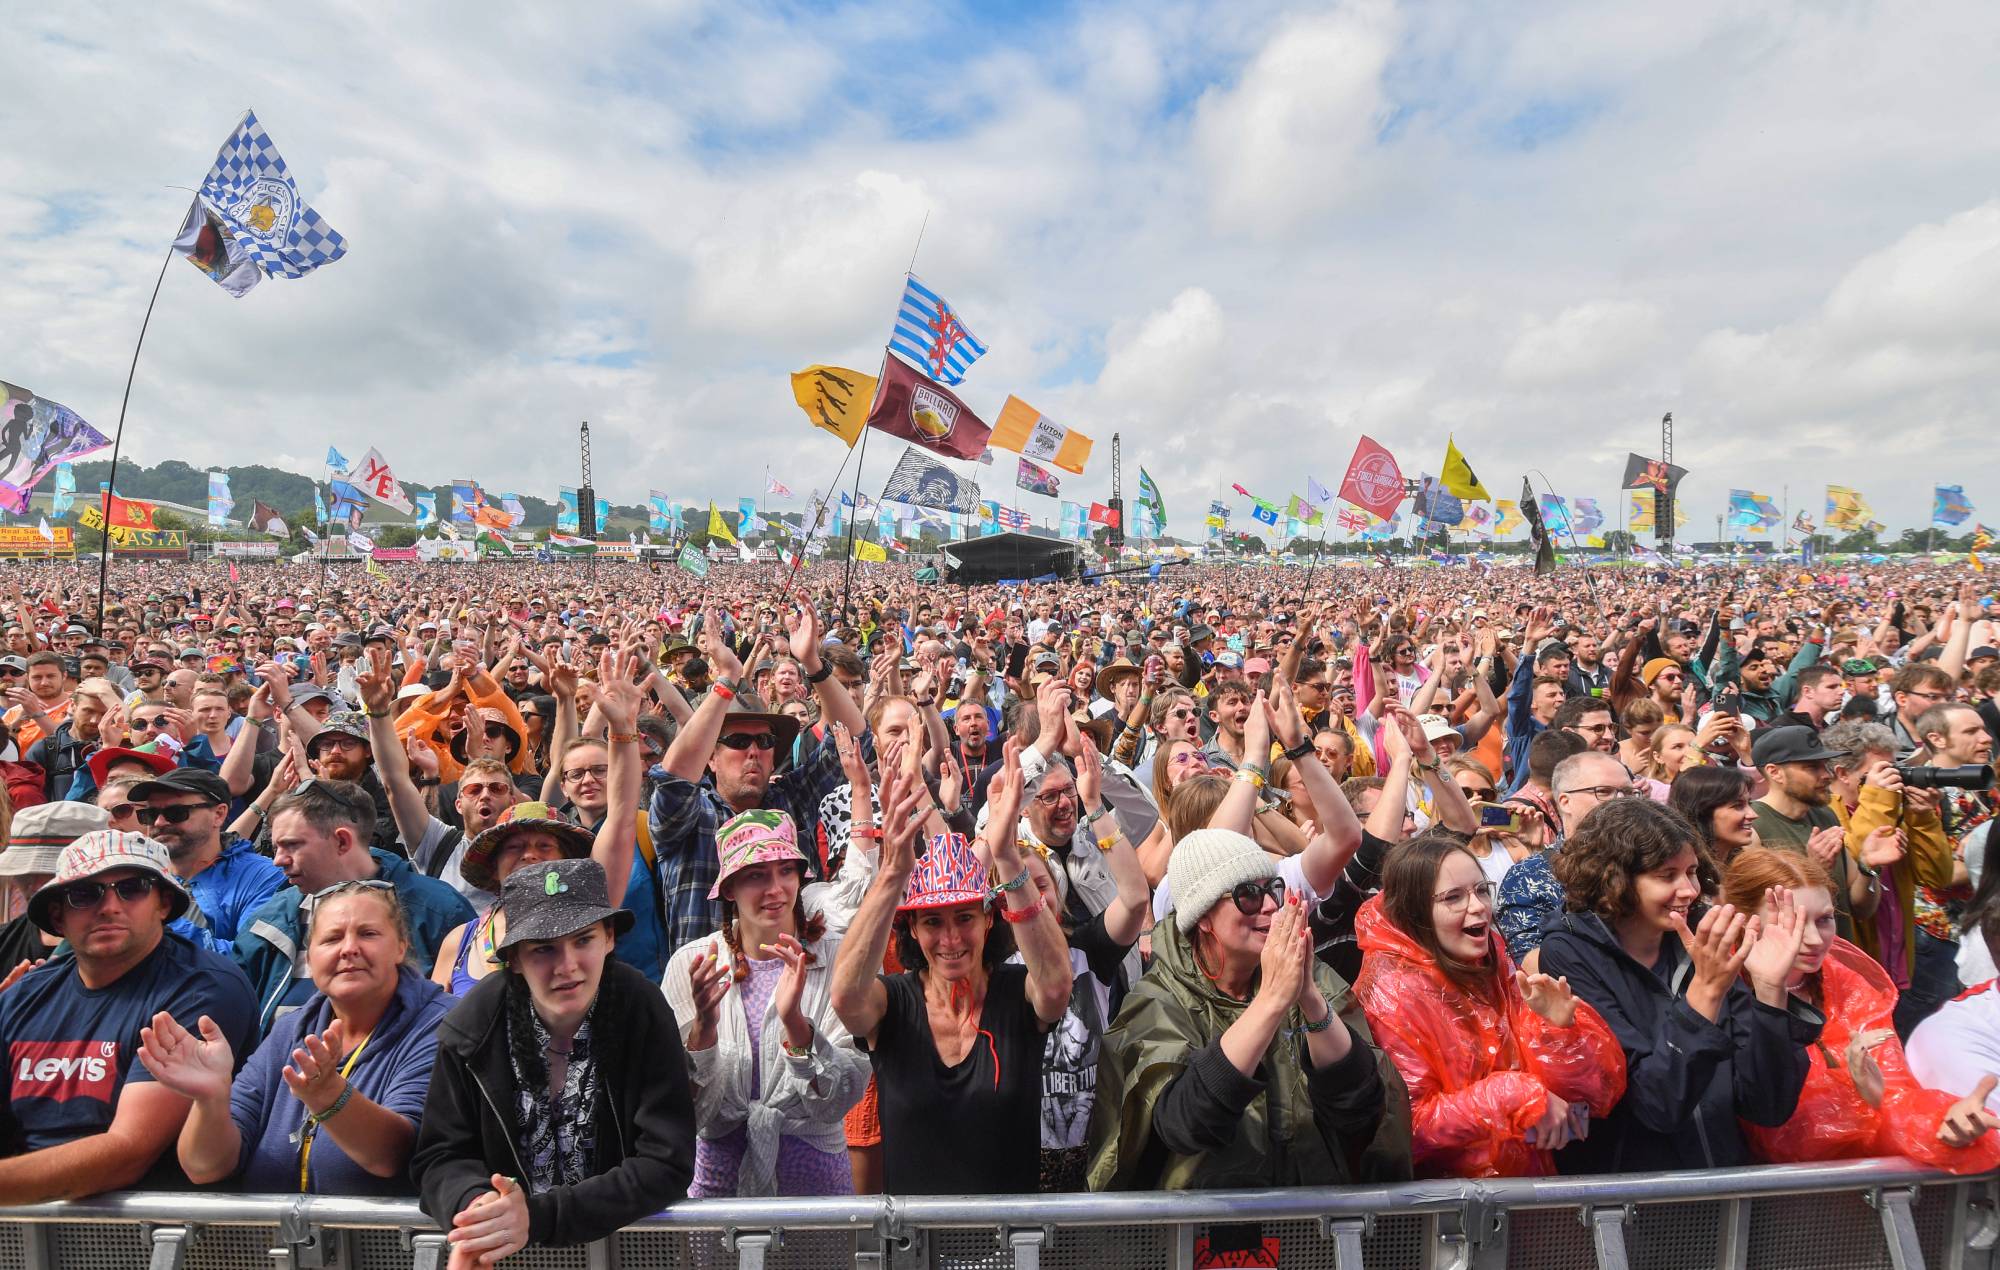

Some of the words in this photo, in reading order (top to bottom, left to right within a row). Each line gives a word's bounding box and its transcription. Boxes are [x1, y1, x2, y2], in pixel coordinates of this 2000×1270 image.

[917, 388, 954, 419] BALLARD
[1038, 421, 1064, 439] LUTON
[126, 531, 182, 546] ASA
[1042, 1063, 1098, 1097] LIBERTIN
